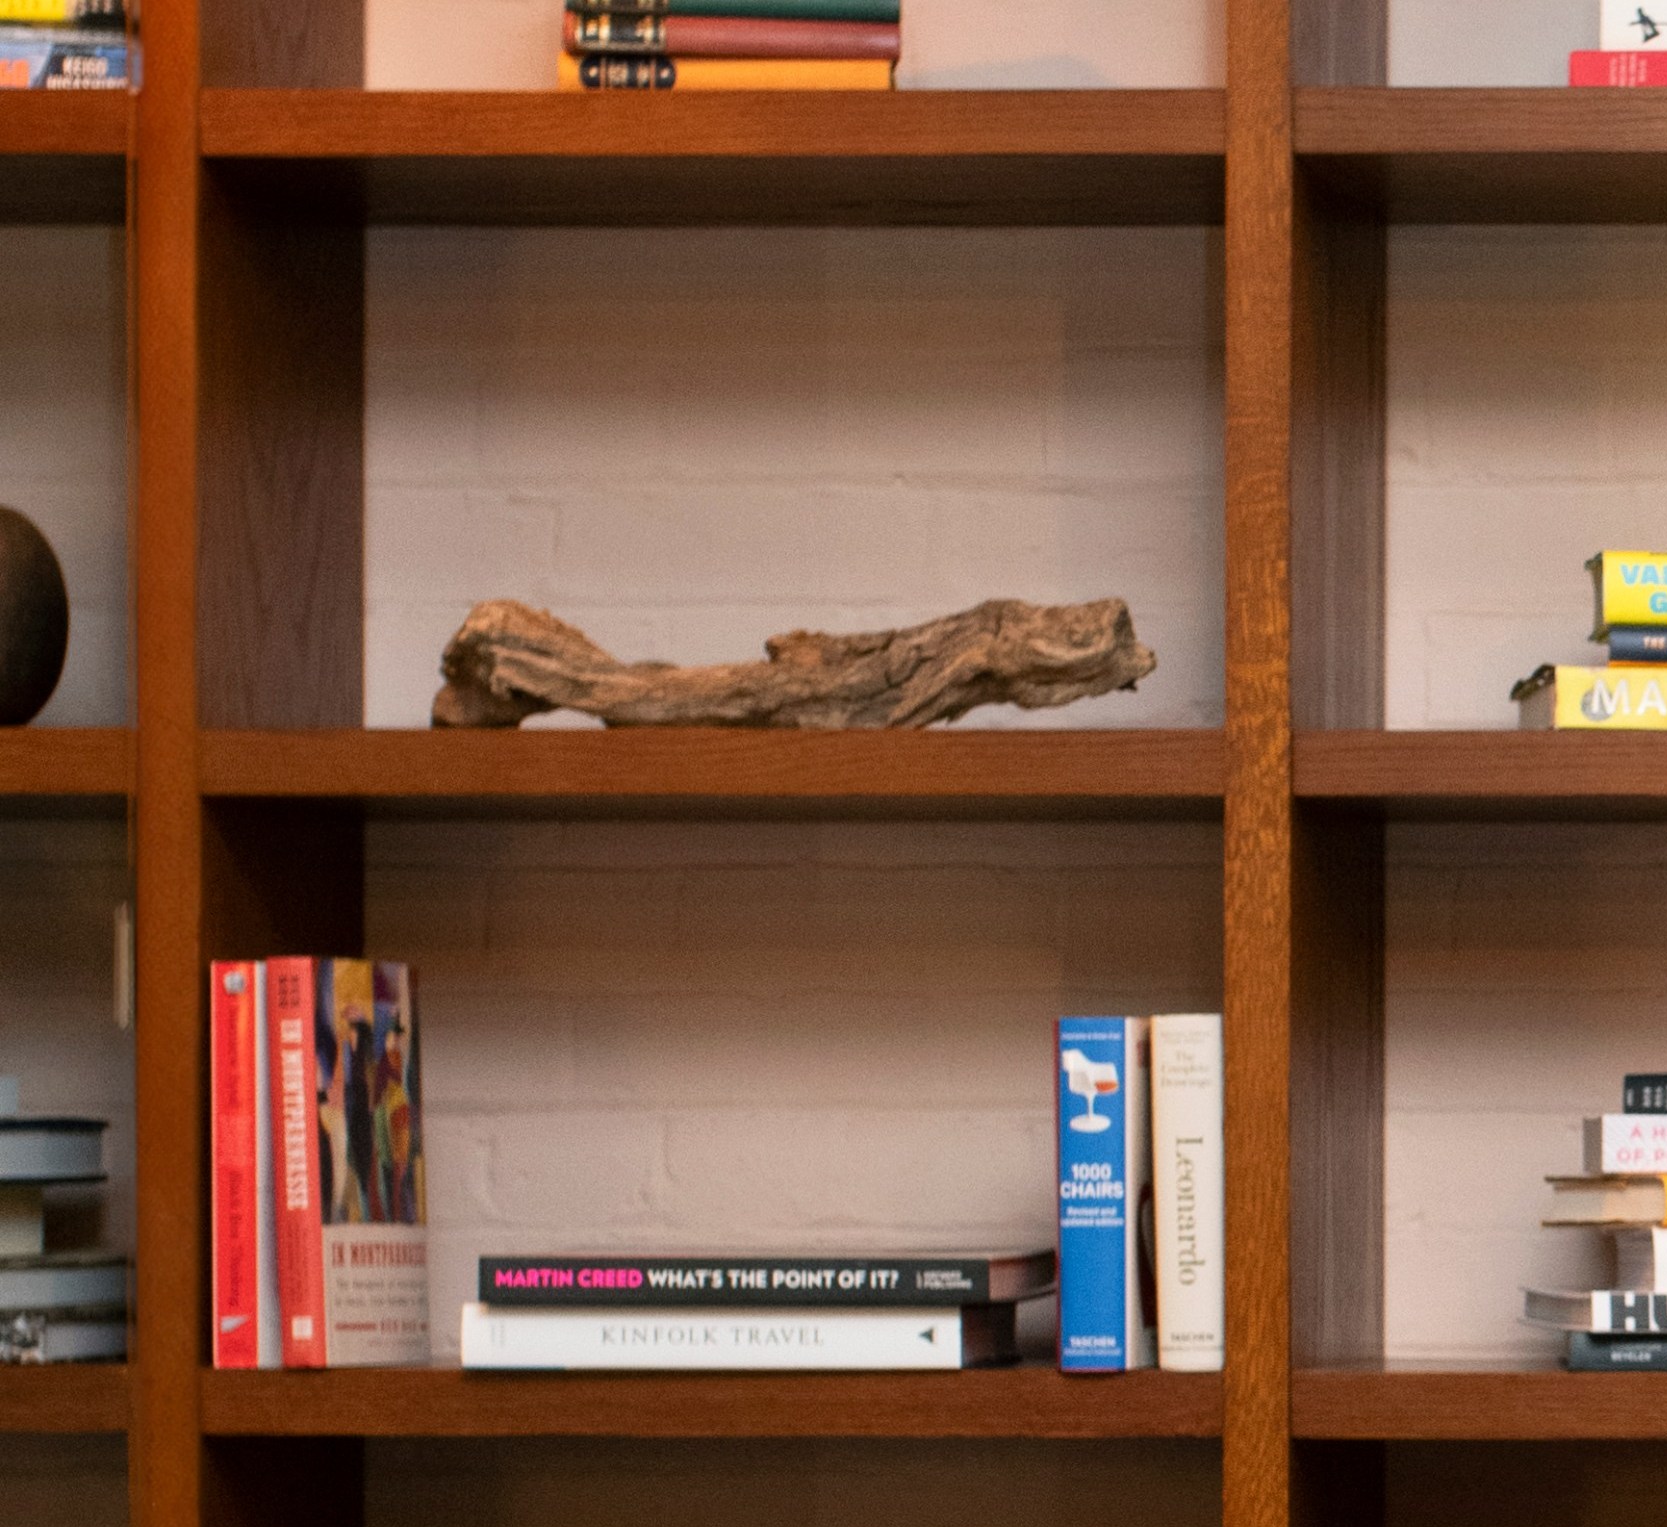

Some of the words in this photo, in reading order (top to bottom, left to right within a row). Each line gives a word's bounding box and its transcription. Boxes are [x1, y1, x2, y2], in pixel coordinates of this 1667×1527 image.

[1643, 636, 1665, 651] THE
[1631, 1125, 1643, 1140] A
[1617, 1149, 1645, 1164] OF
[1071, 1164, 1112, 1181] 1000
[1060, 1181, 1124, 1200] CHAIRS
[1176, 1136, 1206, 1287] Leonardo
[495, 1269, 573, 1289] MARTIN
[578, 1269, 642, 1289] CREED
[728, 1269, 767, 1289] THE
[772, 1269, 834, 1289] POINT
[839, 1269, 866, 1289] OF
[870, 1269, 898, 1289] IT?
[602, 1327, 718, 1346] KINFOLK
[731, 1327, 825, 1346] TRAVEL
